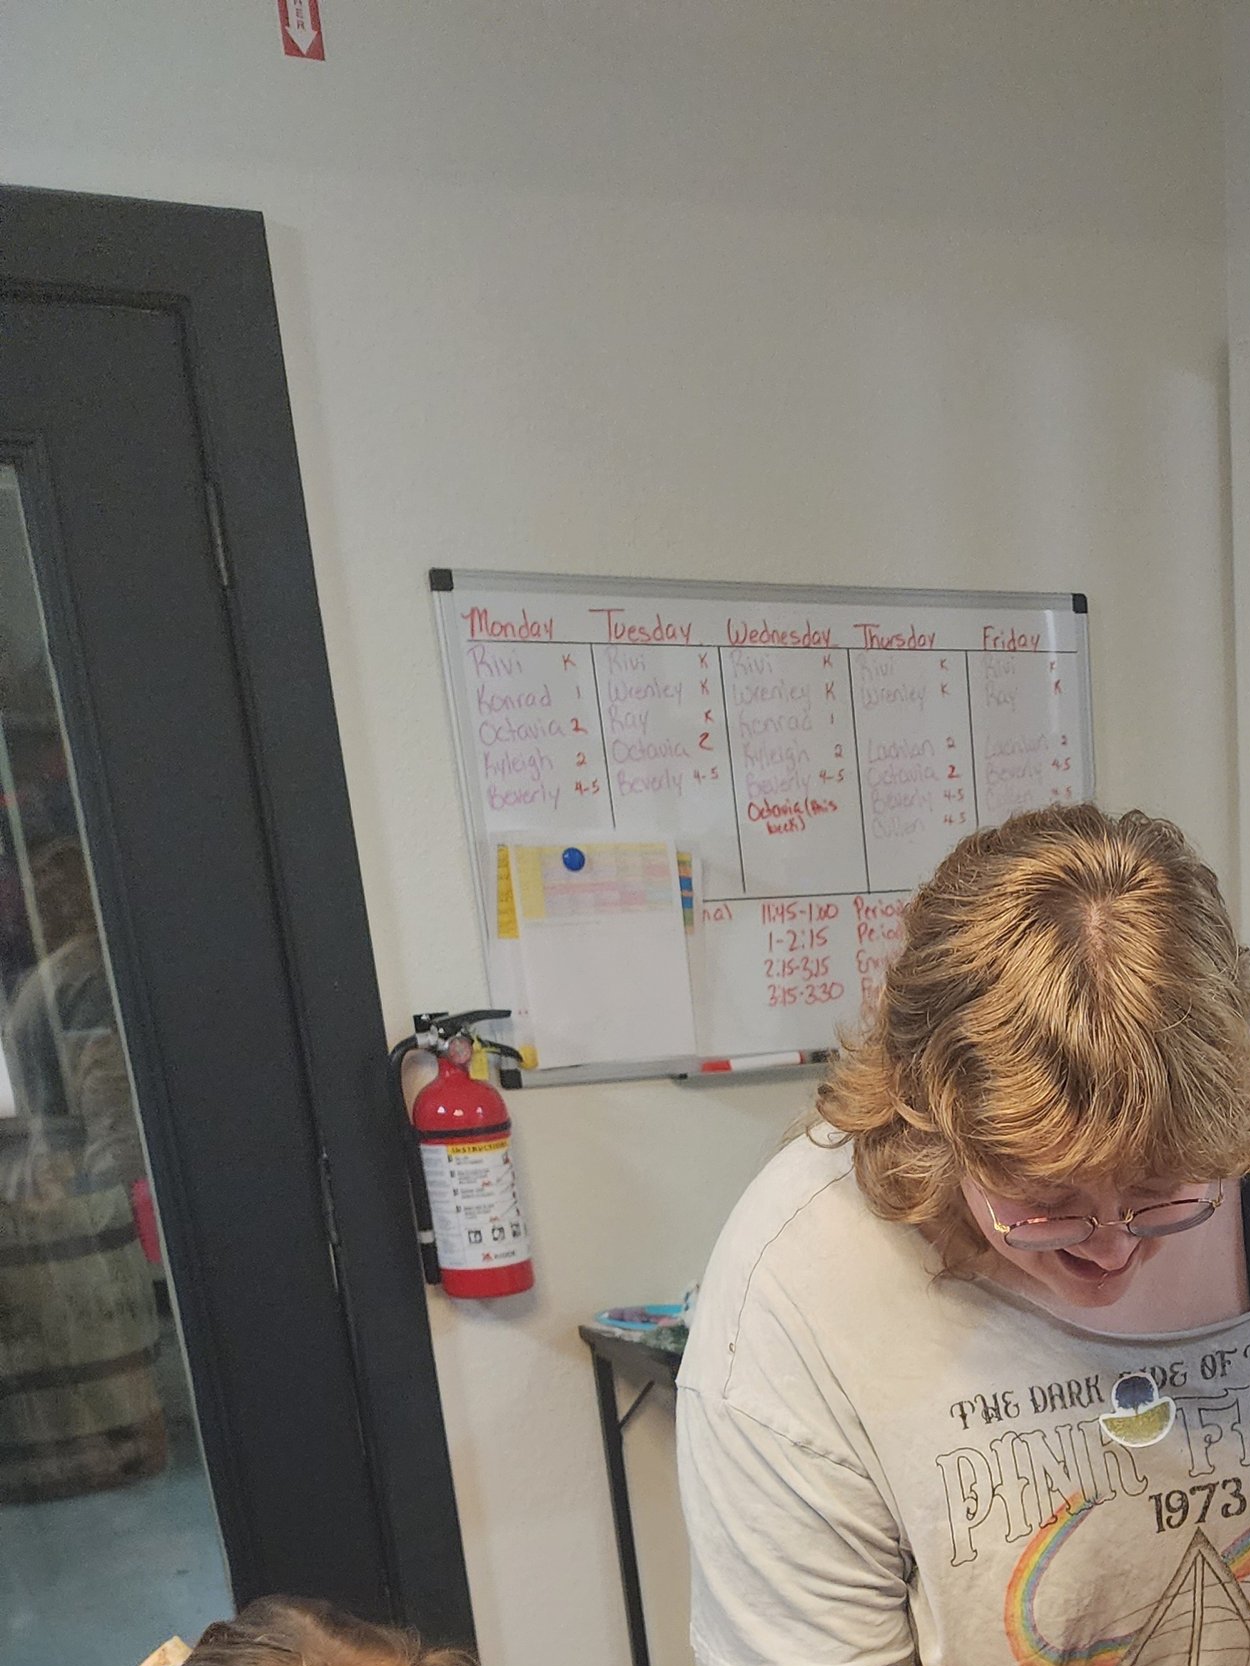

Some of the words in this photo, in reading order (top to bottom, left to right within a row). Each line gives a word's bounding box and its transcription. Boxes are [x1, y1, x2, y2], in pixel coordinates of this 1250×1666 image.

[461, 606, 553, 640] Monday
[589, 608, 692, 643] Tuesday
[727, 618, 833, 648] Wednesday
[853, 624, 936, 651] Thursday
[983, 625, 1041, 651] Friday
[570, 718, 588, 734] 2
[699, 731, 713, 751] 2
[576, 752, 587, 767] 2
[947, 764, 960, 780] 2
[951, 1391, 1020, 1430] THE
[1027, 1375, 1106, 1415] DARK
[1200, 1347, 1238, 1381] OF
[1148, 1477, 1248, 1534] 1973
